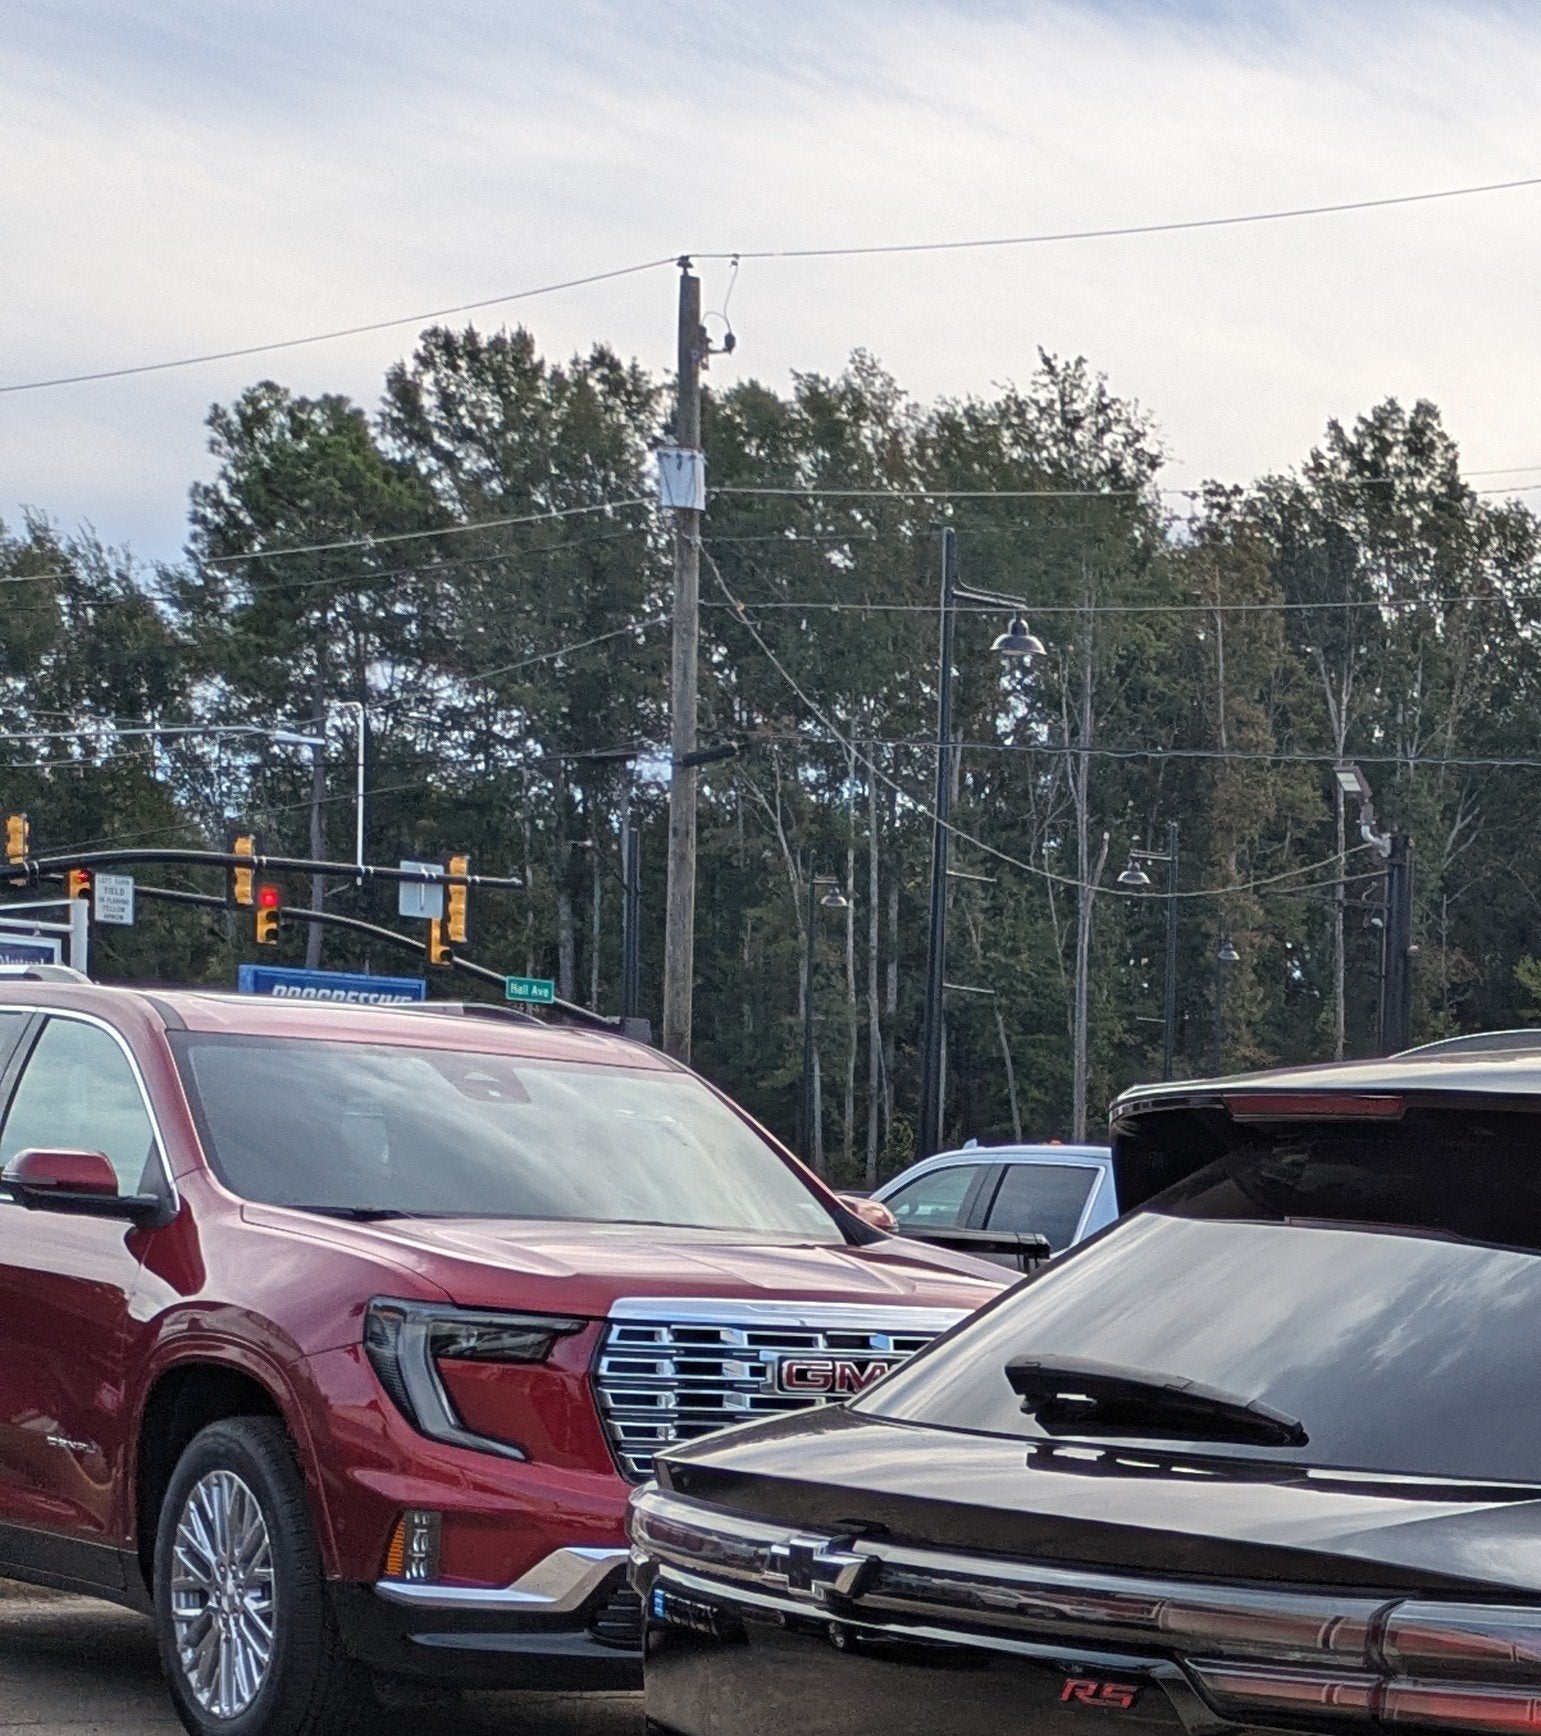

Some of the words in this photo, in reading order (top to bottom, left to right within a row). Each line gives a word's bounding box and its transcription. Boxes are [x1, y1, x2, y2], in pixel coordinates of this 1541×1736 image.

[530, 984, 549, 998] Ave
[782, 1360, 892, 1392] GM
[1059, 1678, 1138, 1709] RS
